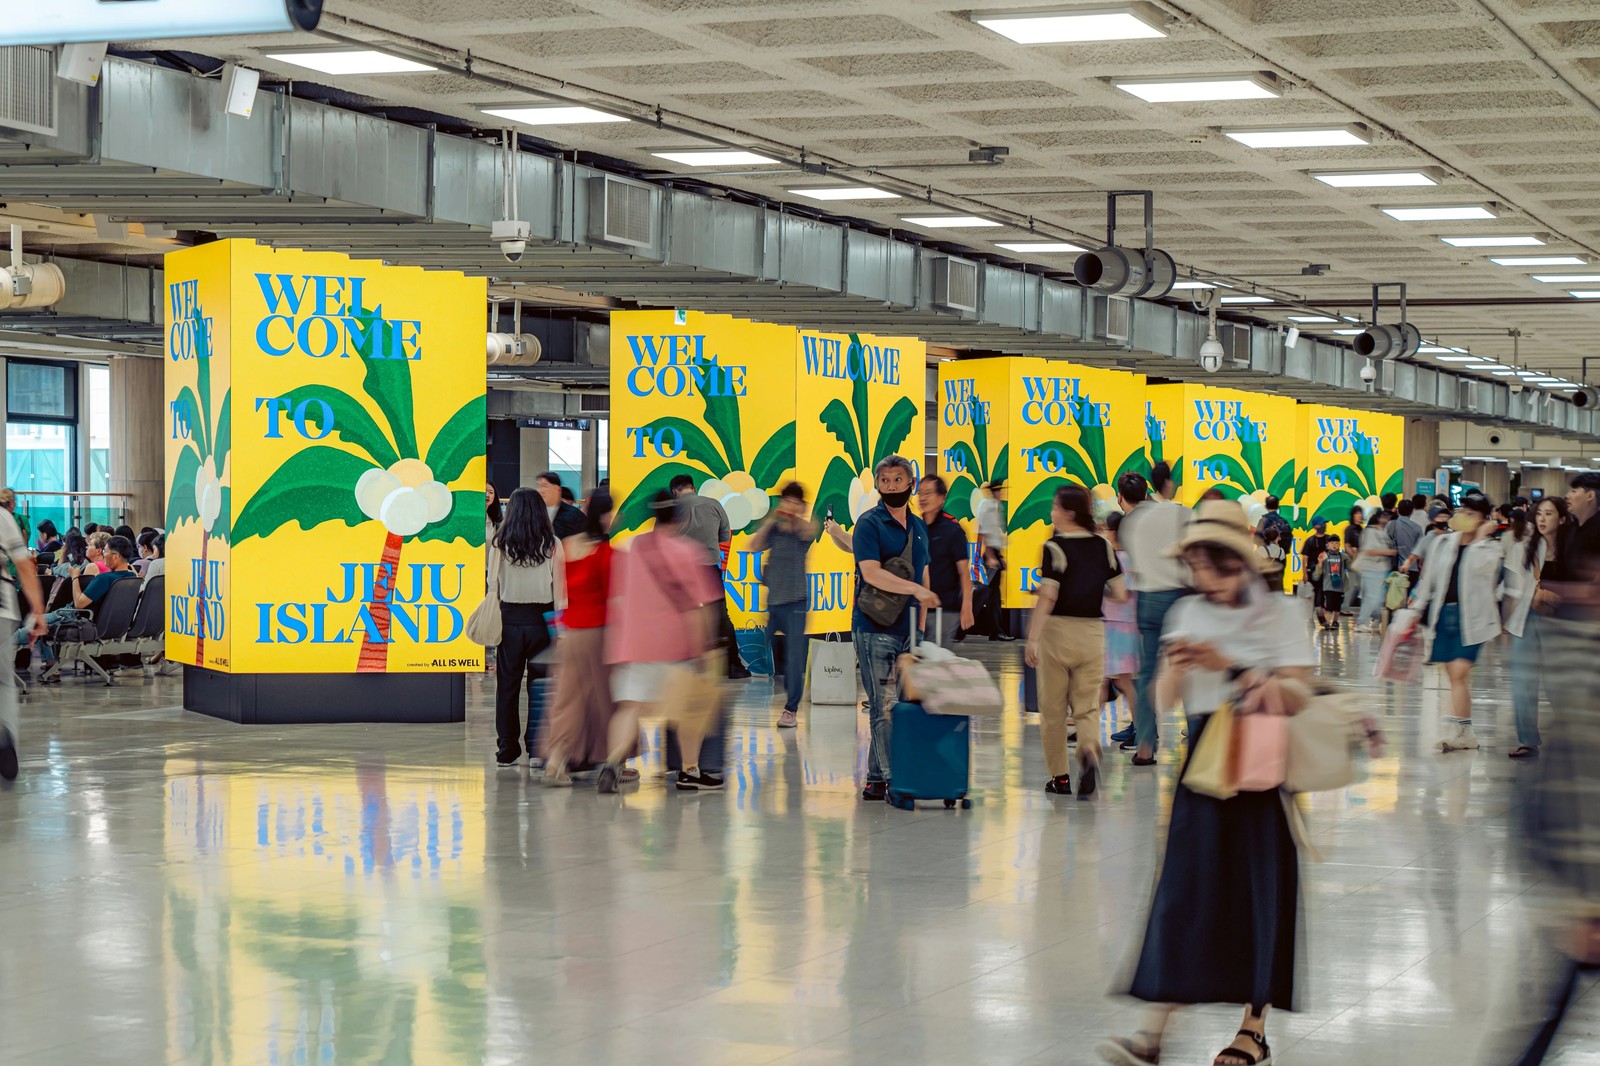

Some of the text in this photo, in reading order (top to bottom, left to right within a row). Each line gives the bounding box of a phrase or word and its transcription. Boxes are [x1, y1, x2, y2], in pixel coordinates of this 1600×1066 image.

[169, 279, 202, 320] WEL
[254, 273, 382, 318] WEL
[170, 317, 213, 361] COME
[255, 314, 422, 361] COME
[626, 335, 717, 366] WEL
[802, 336, 900, 385] WELCOME
[627, 365, 747, 397] COME
[944, 378, 980, 404] WEL
[1022, 376, 1089, 402] WEL
[170, 399, 191, 439] TO
[255, 397, 335, 440] TO
[944, 401, 991, 426] COME
[1022, 400, 1111, 427] COME
[1194, 400, 1250, 422] WEL
[627, 426, 683, 458] TO
[1194, 420, 1267, 442] COME
[1317, 418, 1365, 438] WEL
[1021, 448, 1064, 473] TO
[1317, 436, 1379, 454] COME
[944, 449, 966, 473] TO
[1194, 459, 1229, 480] TO
[1316, 469, 1347, 488] TO
[188, 558, 225, 601] JEJU
[326, 563, 466, 603] JEJU
[806, 572, 849, 611] JEJU
[171, 594, 225, 641] ISLAND
[255, 602, 464, 644] ISLAND
[431, 659, 447, 667] ALL
[448, 659, 457, 667] IS
[458, 659, 480, 667] WELL
